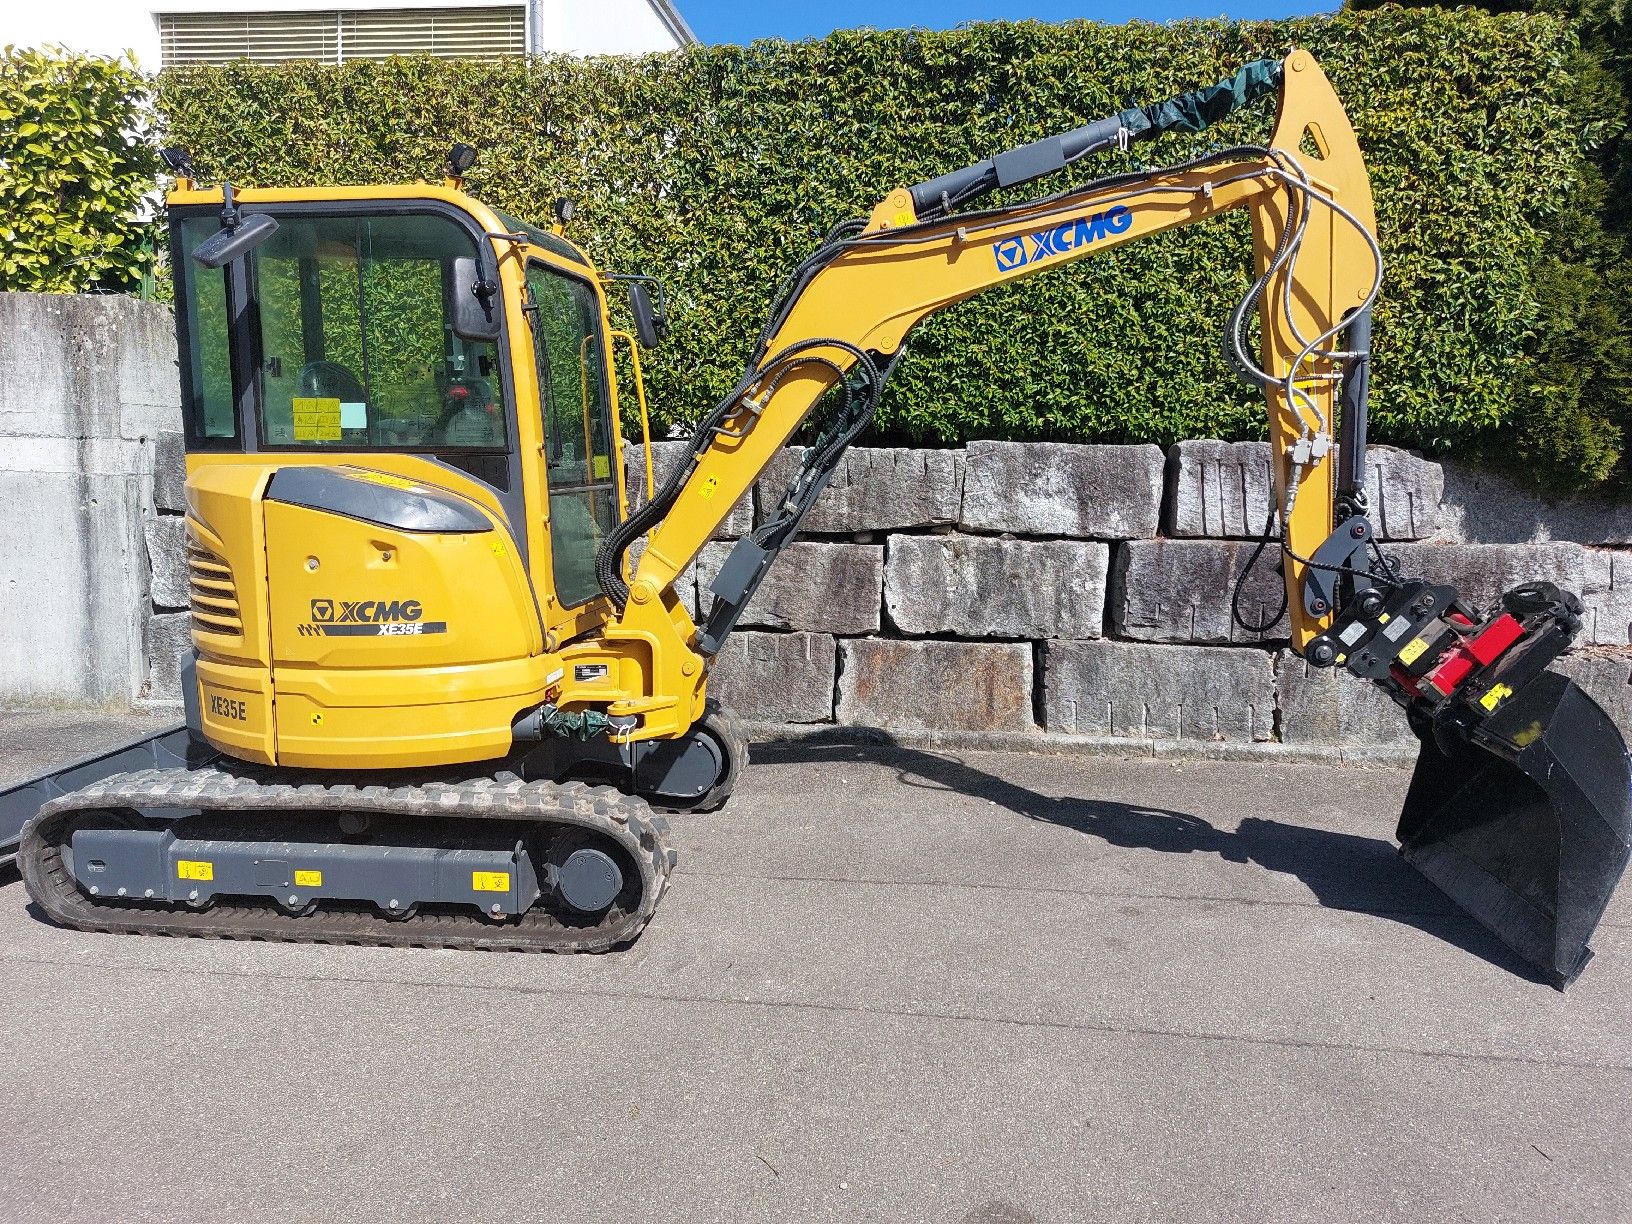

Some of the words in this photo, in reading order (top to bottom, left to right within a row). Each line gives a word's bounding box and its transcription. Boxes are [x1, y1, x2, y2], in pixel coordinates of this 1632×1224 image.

[1030, 205, 1133, 263] XCMG
[335, 600, 423, 622] XCMG
[377, 623, 424, 635] XE35E
[211, 694, 246, 721] XE35E
